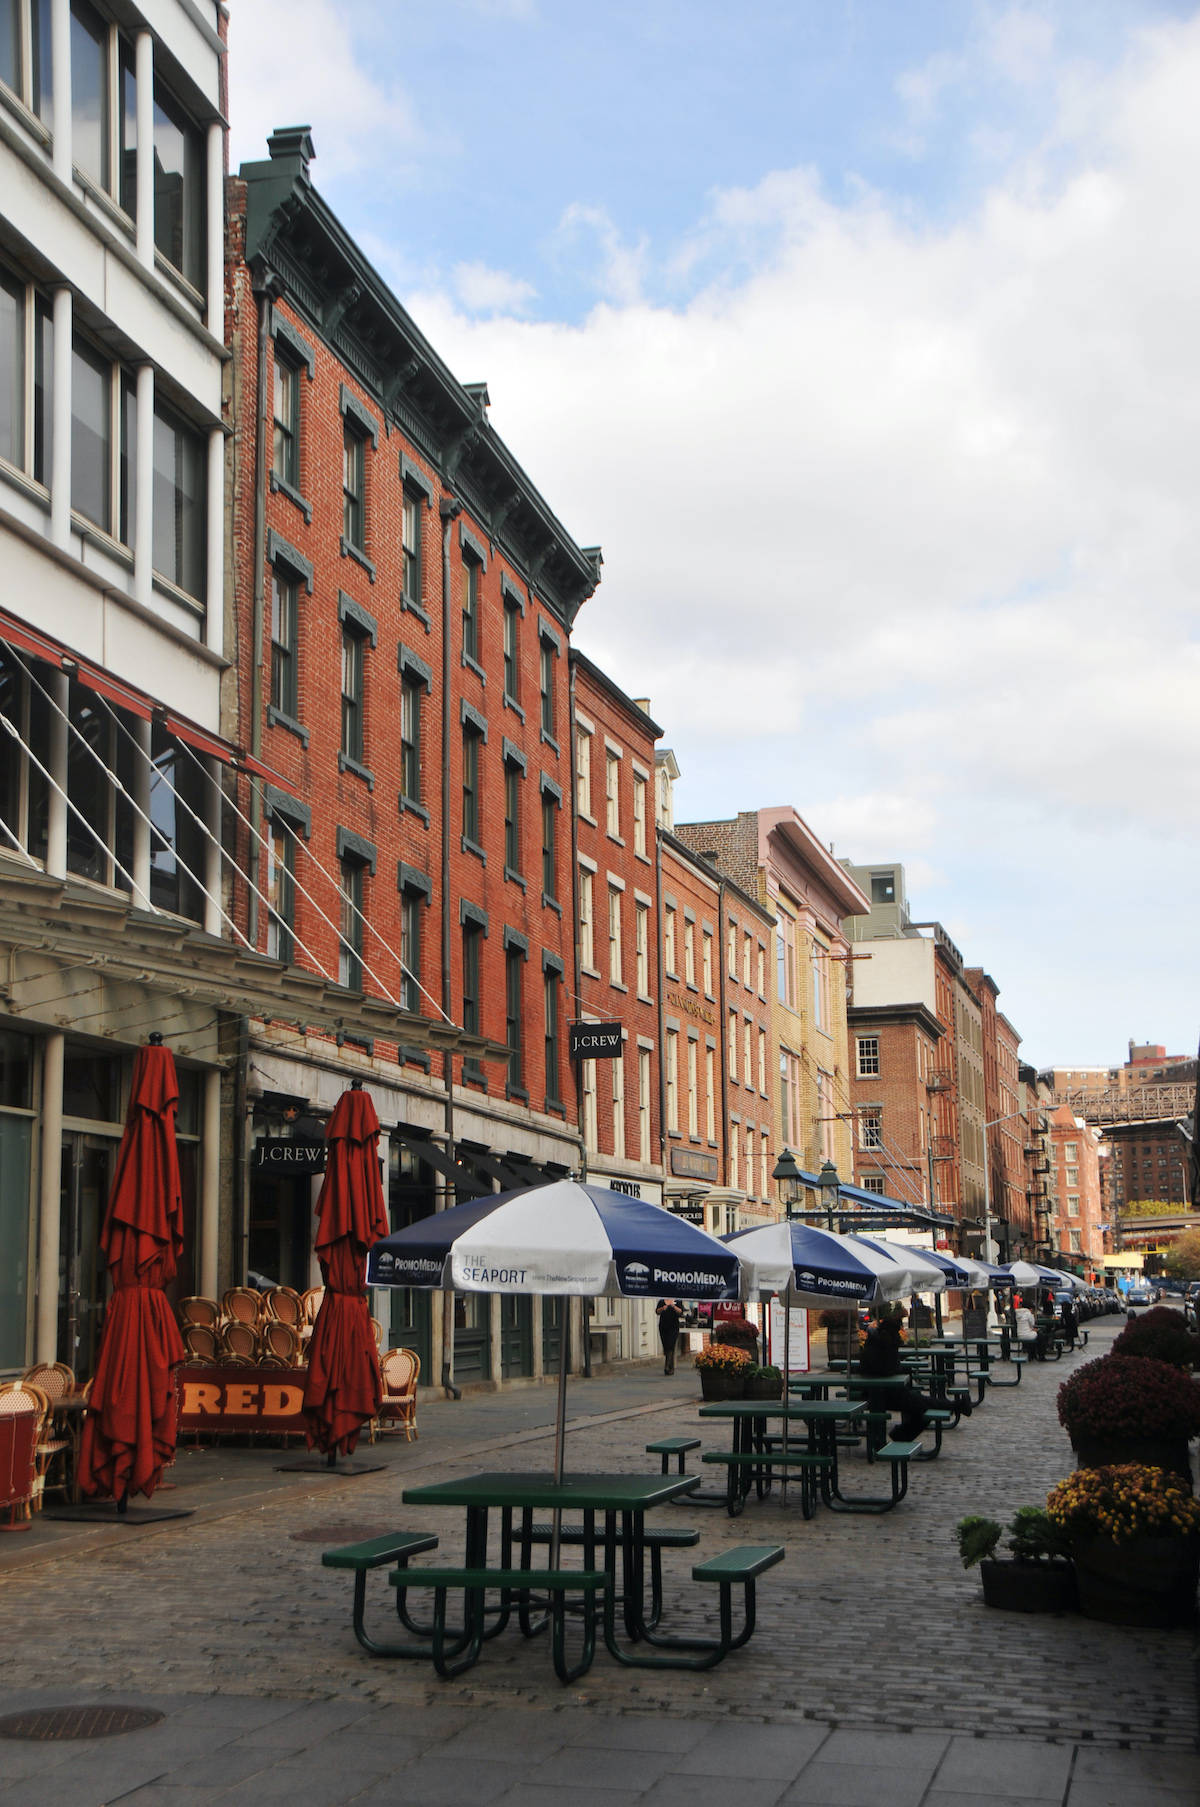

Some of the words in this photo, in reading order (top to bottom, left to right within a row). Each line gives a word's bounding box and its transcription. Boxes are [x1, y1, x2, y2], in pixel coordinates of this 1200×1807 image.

[573, 1035, 619, 1051] J.CREW
[258, 1146, 321, 1165] J.CREW
[464, 1255, 487, 1267] THE
[462, 1268, 527, 1284] SEAPORT
[182, 1382, 305, 1416] RED
